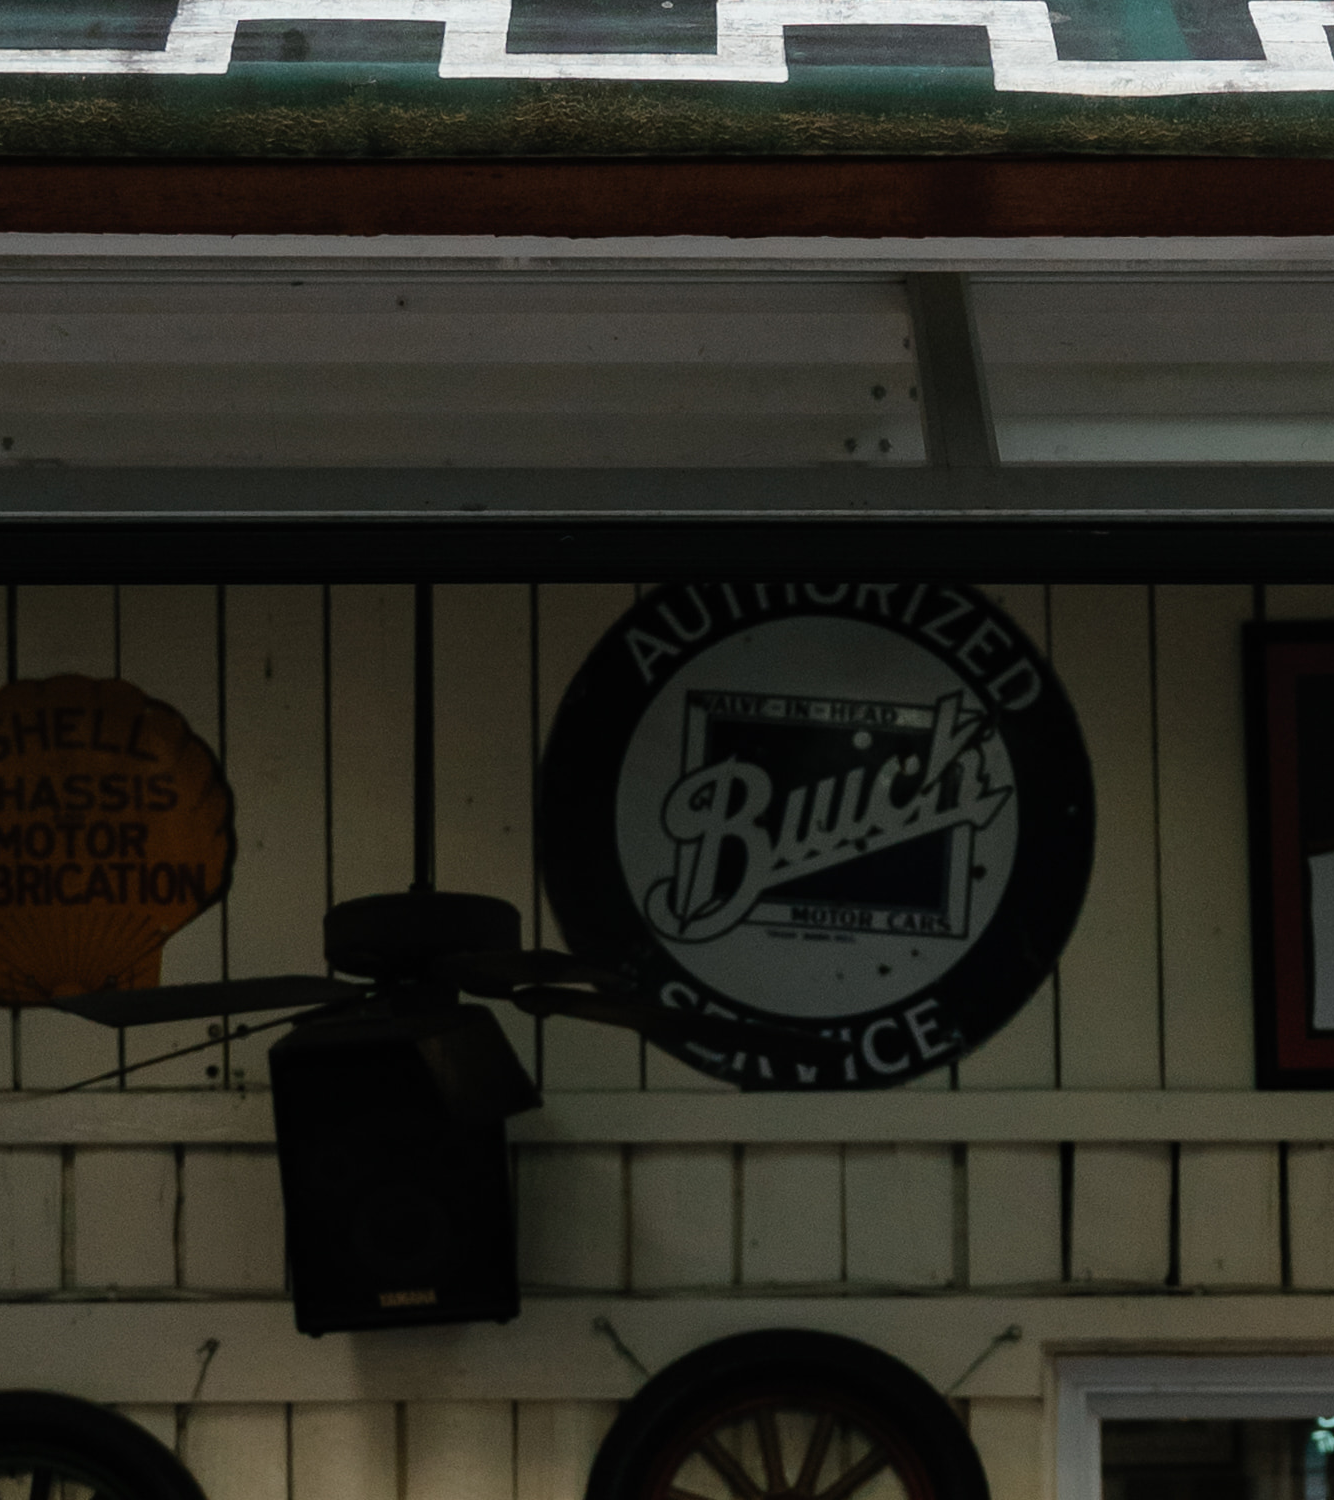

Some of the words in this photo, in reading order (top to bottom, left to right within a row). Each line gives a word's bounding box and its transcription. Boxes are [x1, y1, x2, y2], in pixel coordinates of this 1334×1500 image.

[645, 691, 1014, 943] Buick
[791, 906, 873, 928] MOTOR
[888, 911, 952, 933] CARS
